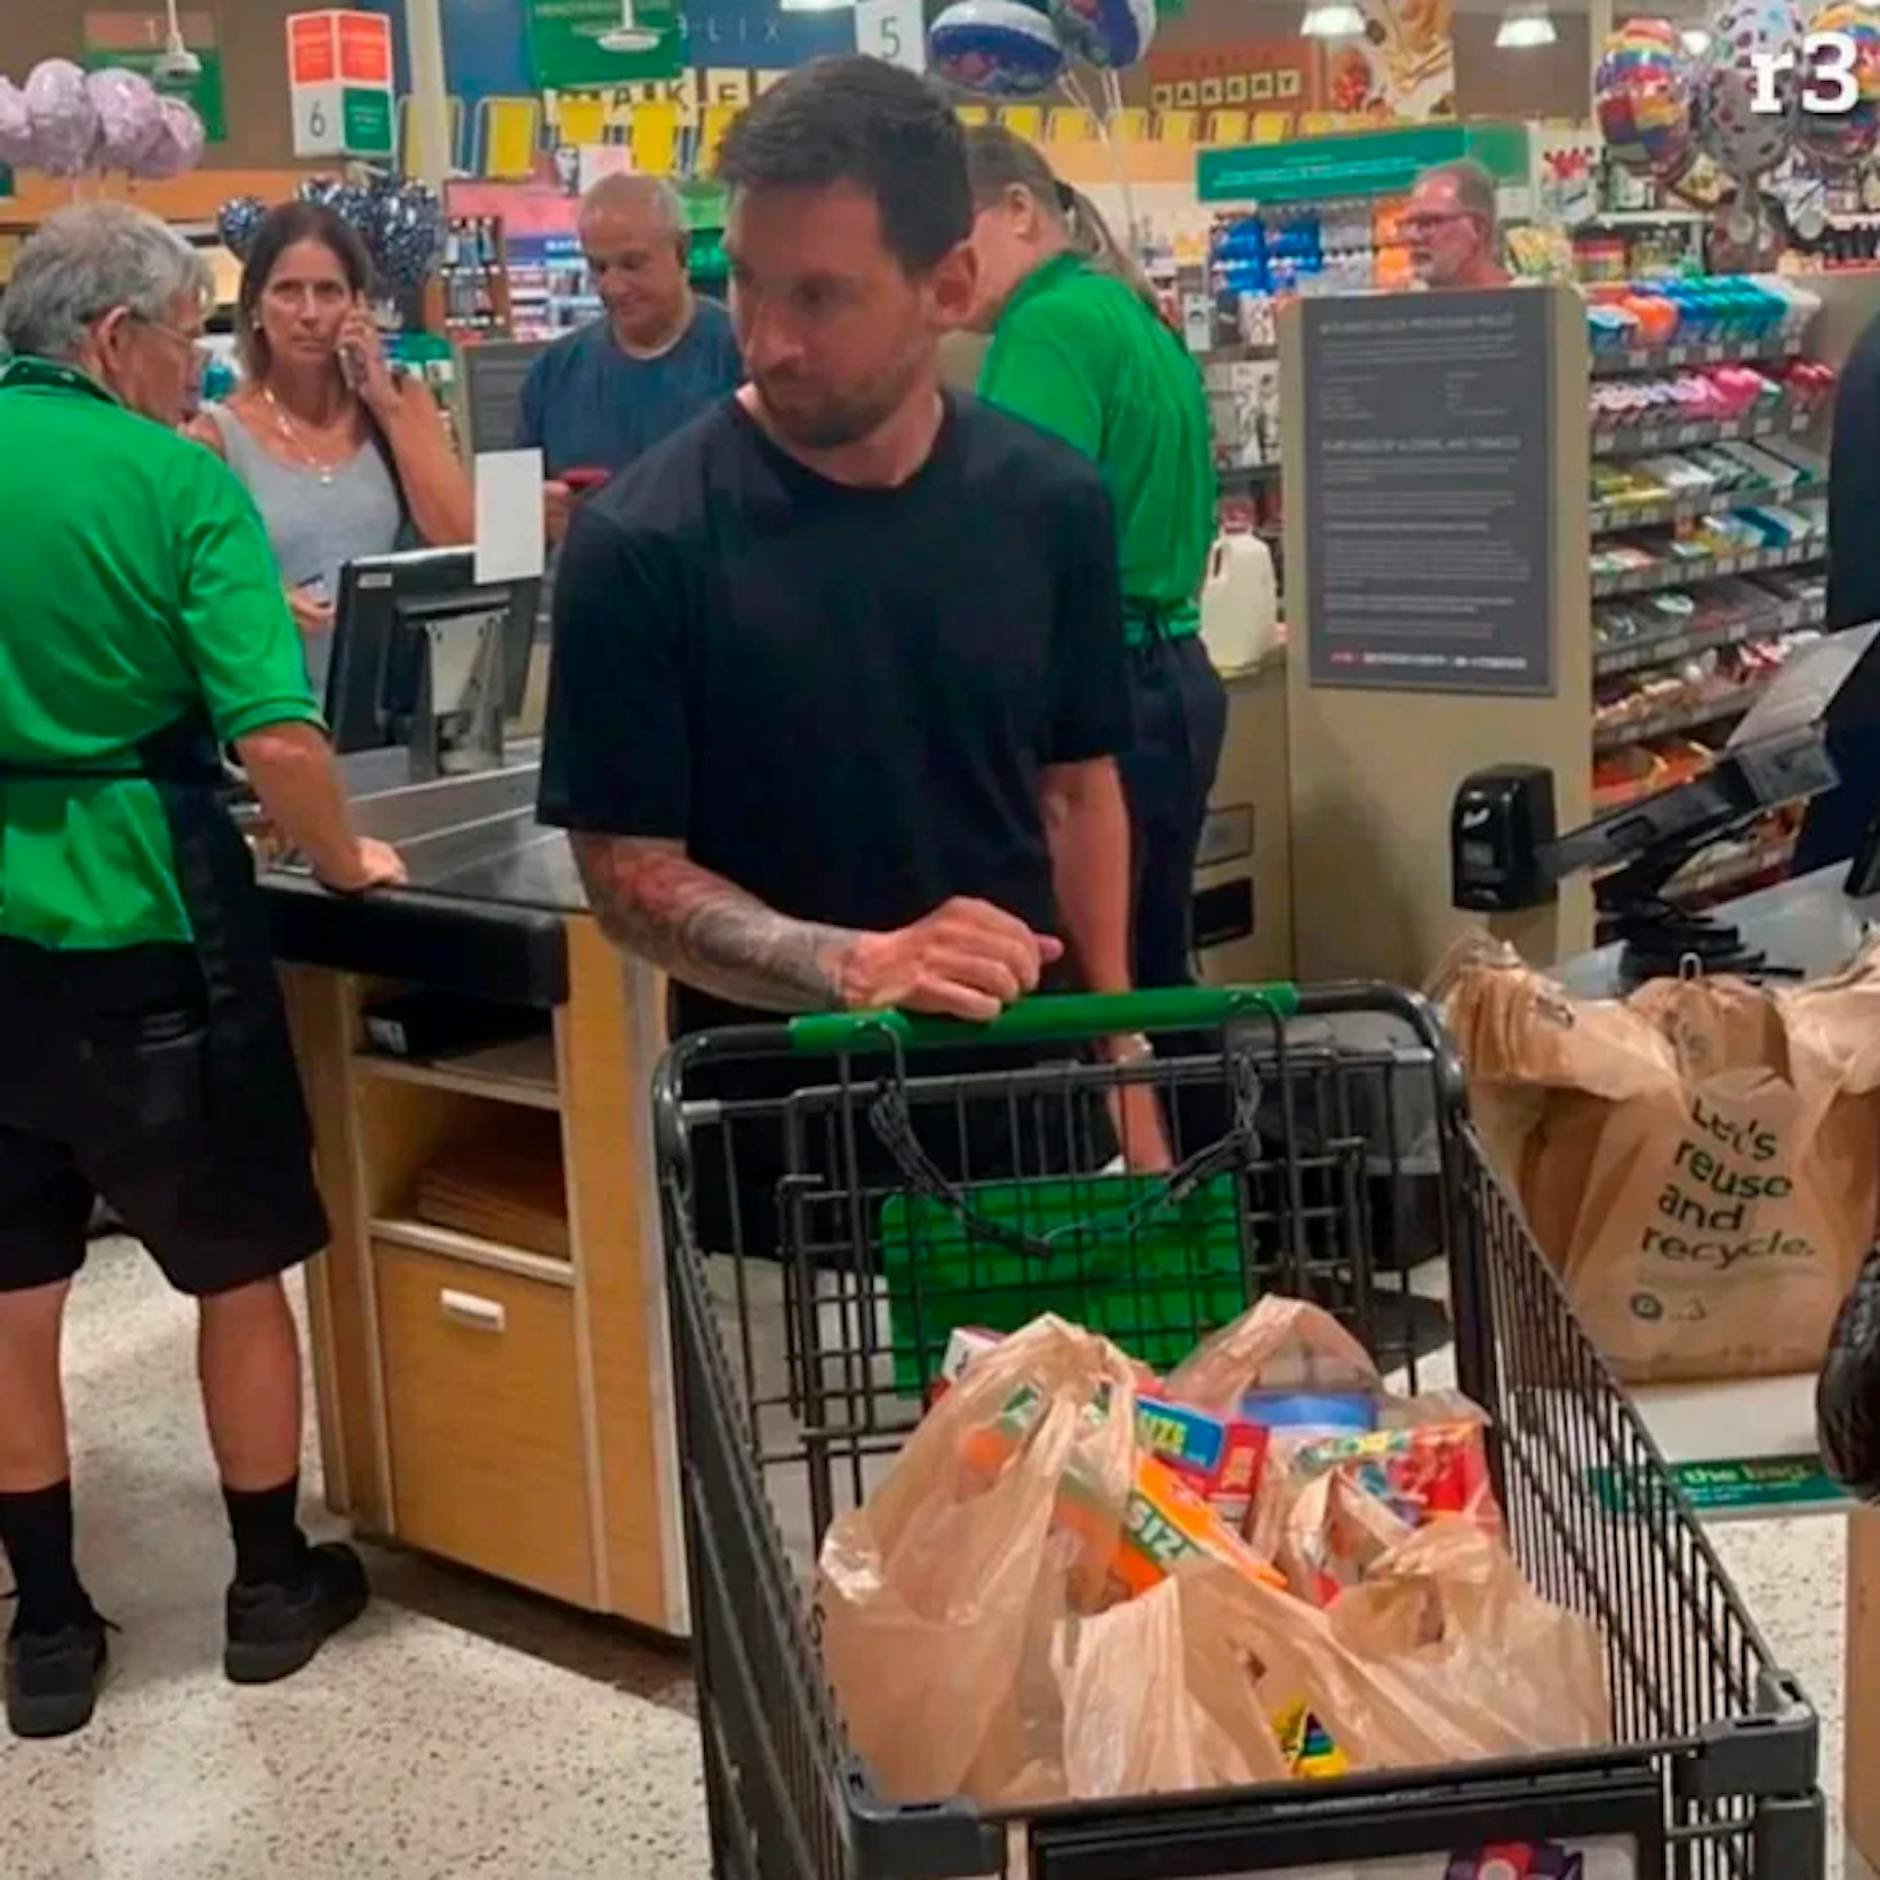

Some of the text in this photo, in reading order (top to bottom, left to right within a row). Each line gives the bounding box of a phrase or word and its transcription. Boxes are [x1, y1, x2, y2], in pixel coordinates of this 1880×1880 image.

[881, 16, 900, 59] 5
[1155, 74, 1297, 103] BAKERY
[309, 100, 325, 137] 6
[1674, 1139, 1793, 1199] reuse
[1657, 1183, 1744, 1231] and
